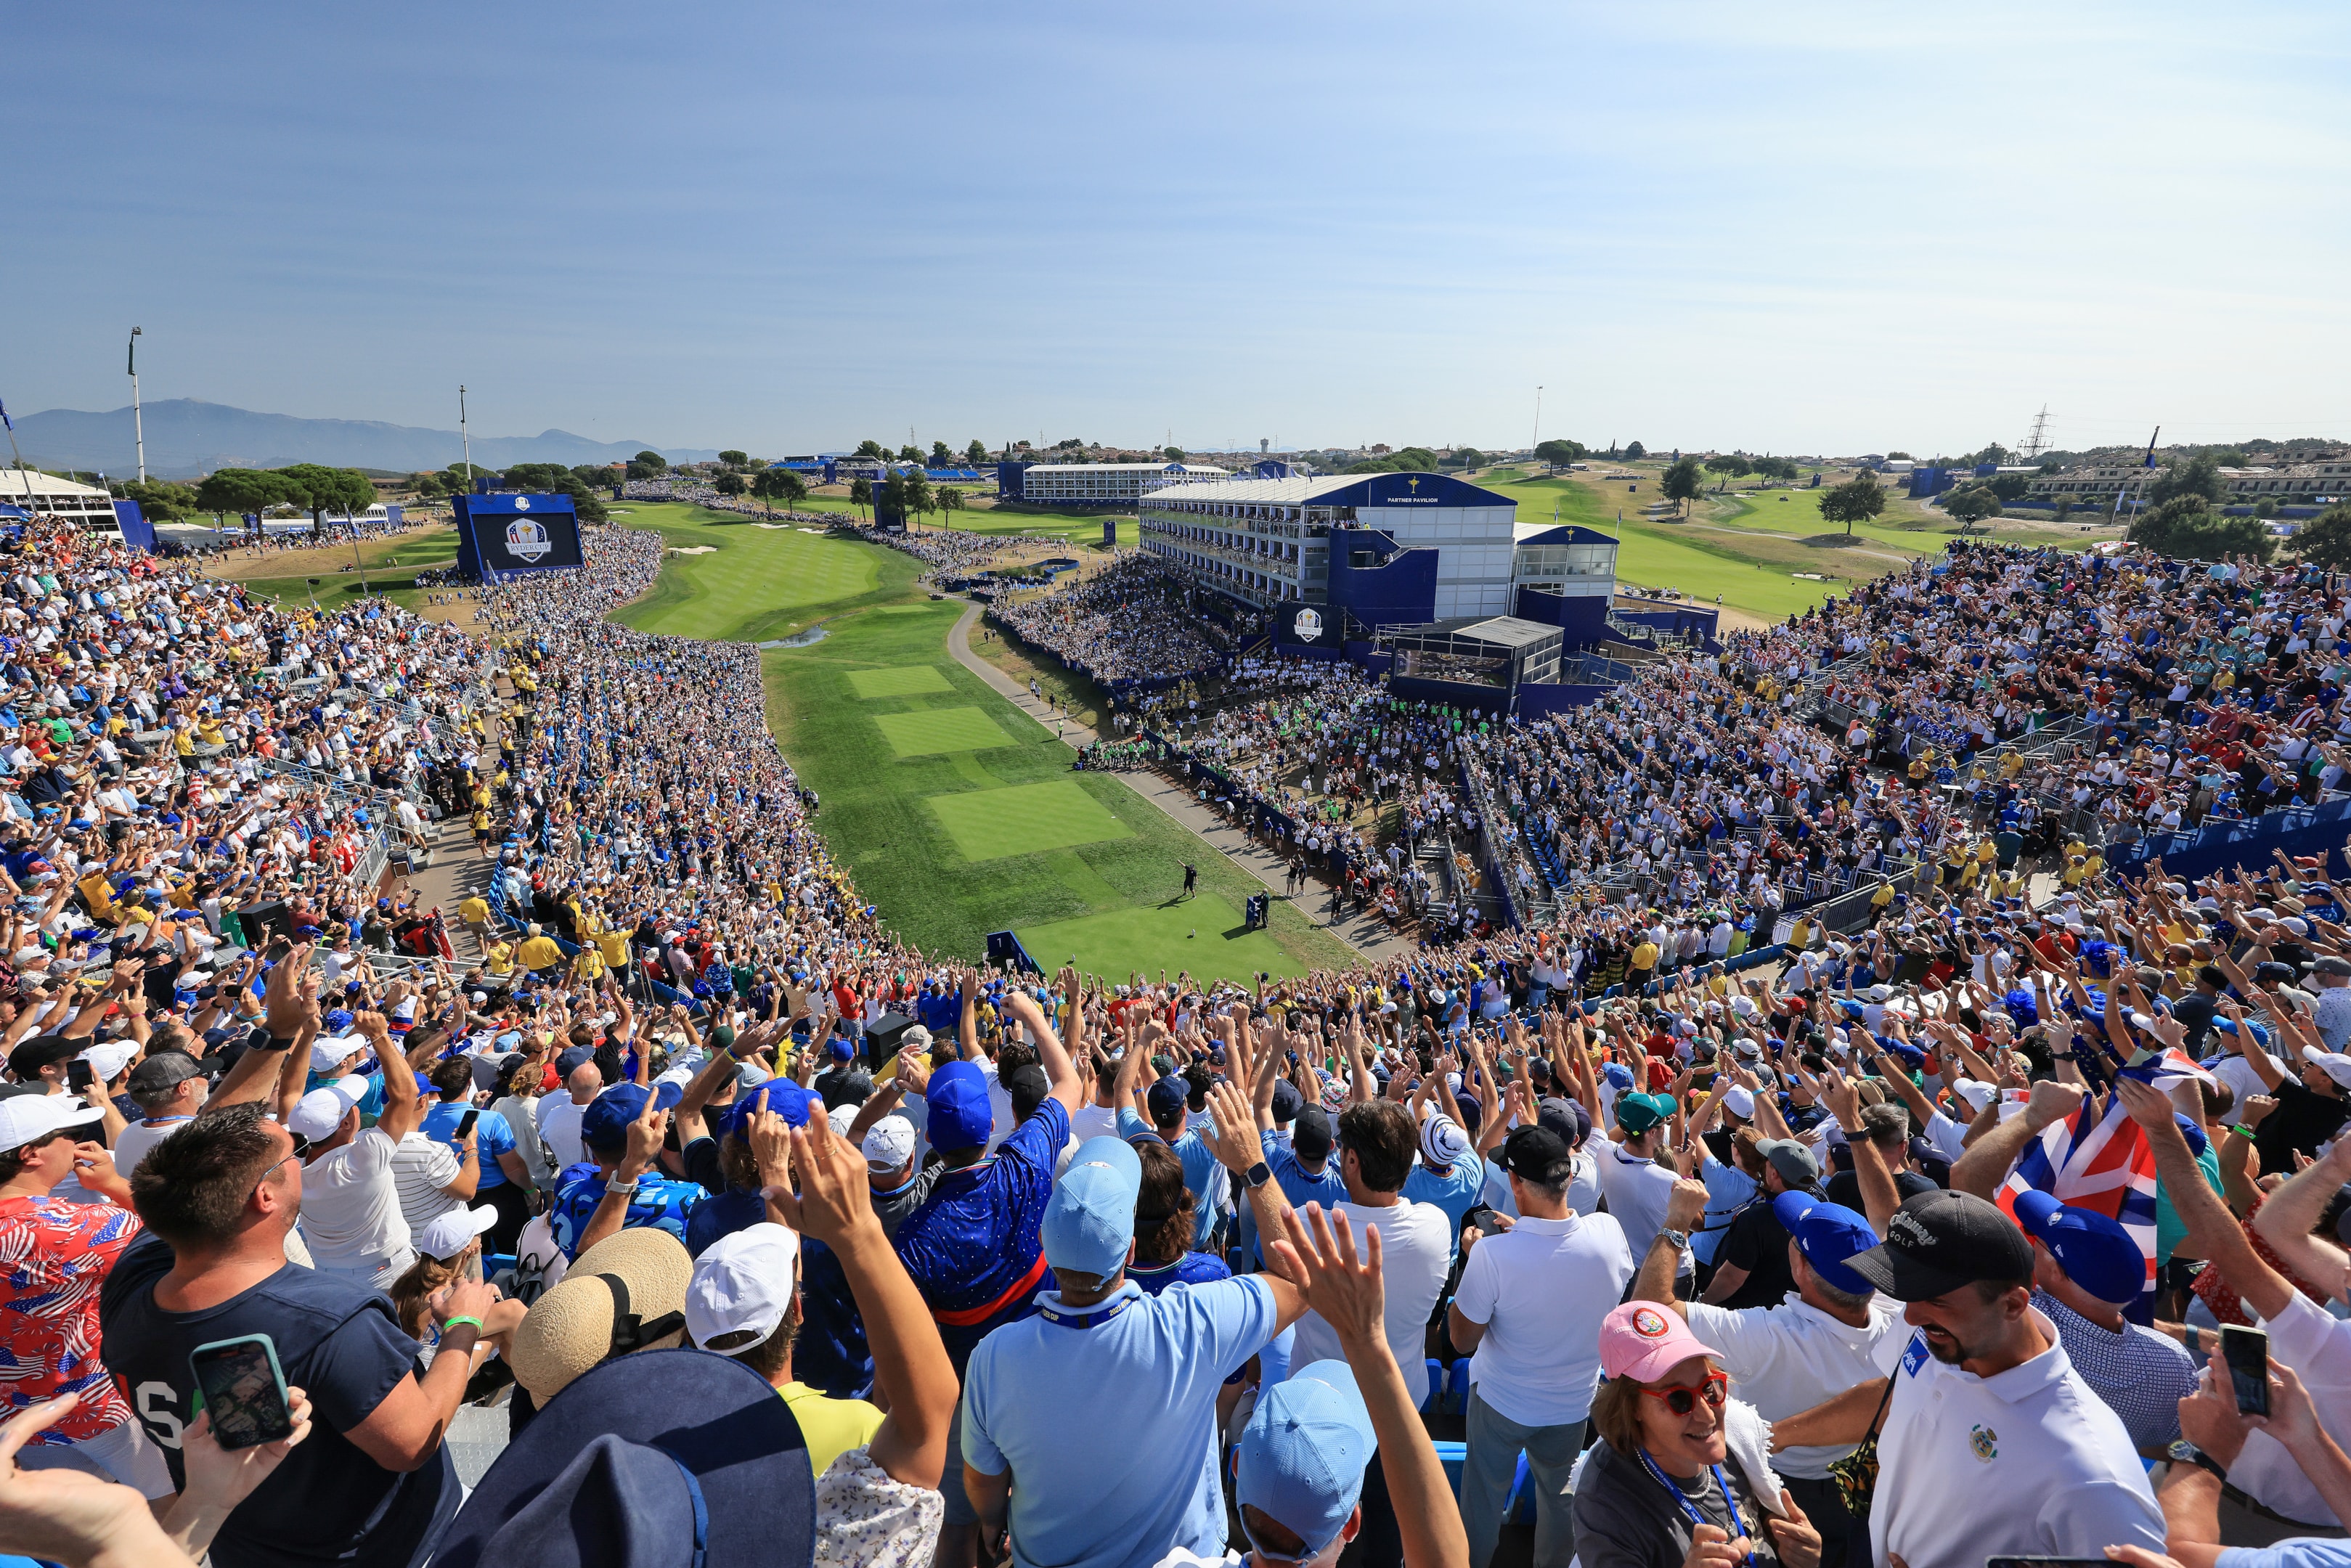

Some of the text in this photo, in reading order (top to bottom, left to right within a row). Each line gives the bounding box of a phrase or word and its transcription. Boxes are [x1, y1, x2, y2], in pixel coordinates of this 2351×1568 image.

[996, 937, 1002, 948] 1
[1889, 1230, 1915, 1248] GOLF
[1050, 1312, 1059, 1321] CUP
[1109, 1304, 1122, 1317] 2023
[1903, 1352, 1917, 1372] AXA
[1647, 1458, 1658, 1471] RADIO
[1663, 1477, 1674, 1491] RYDER
